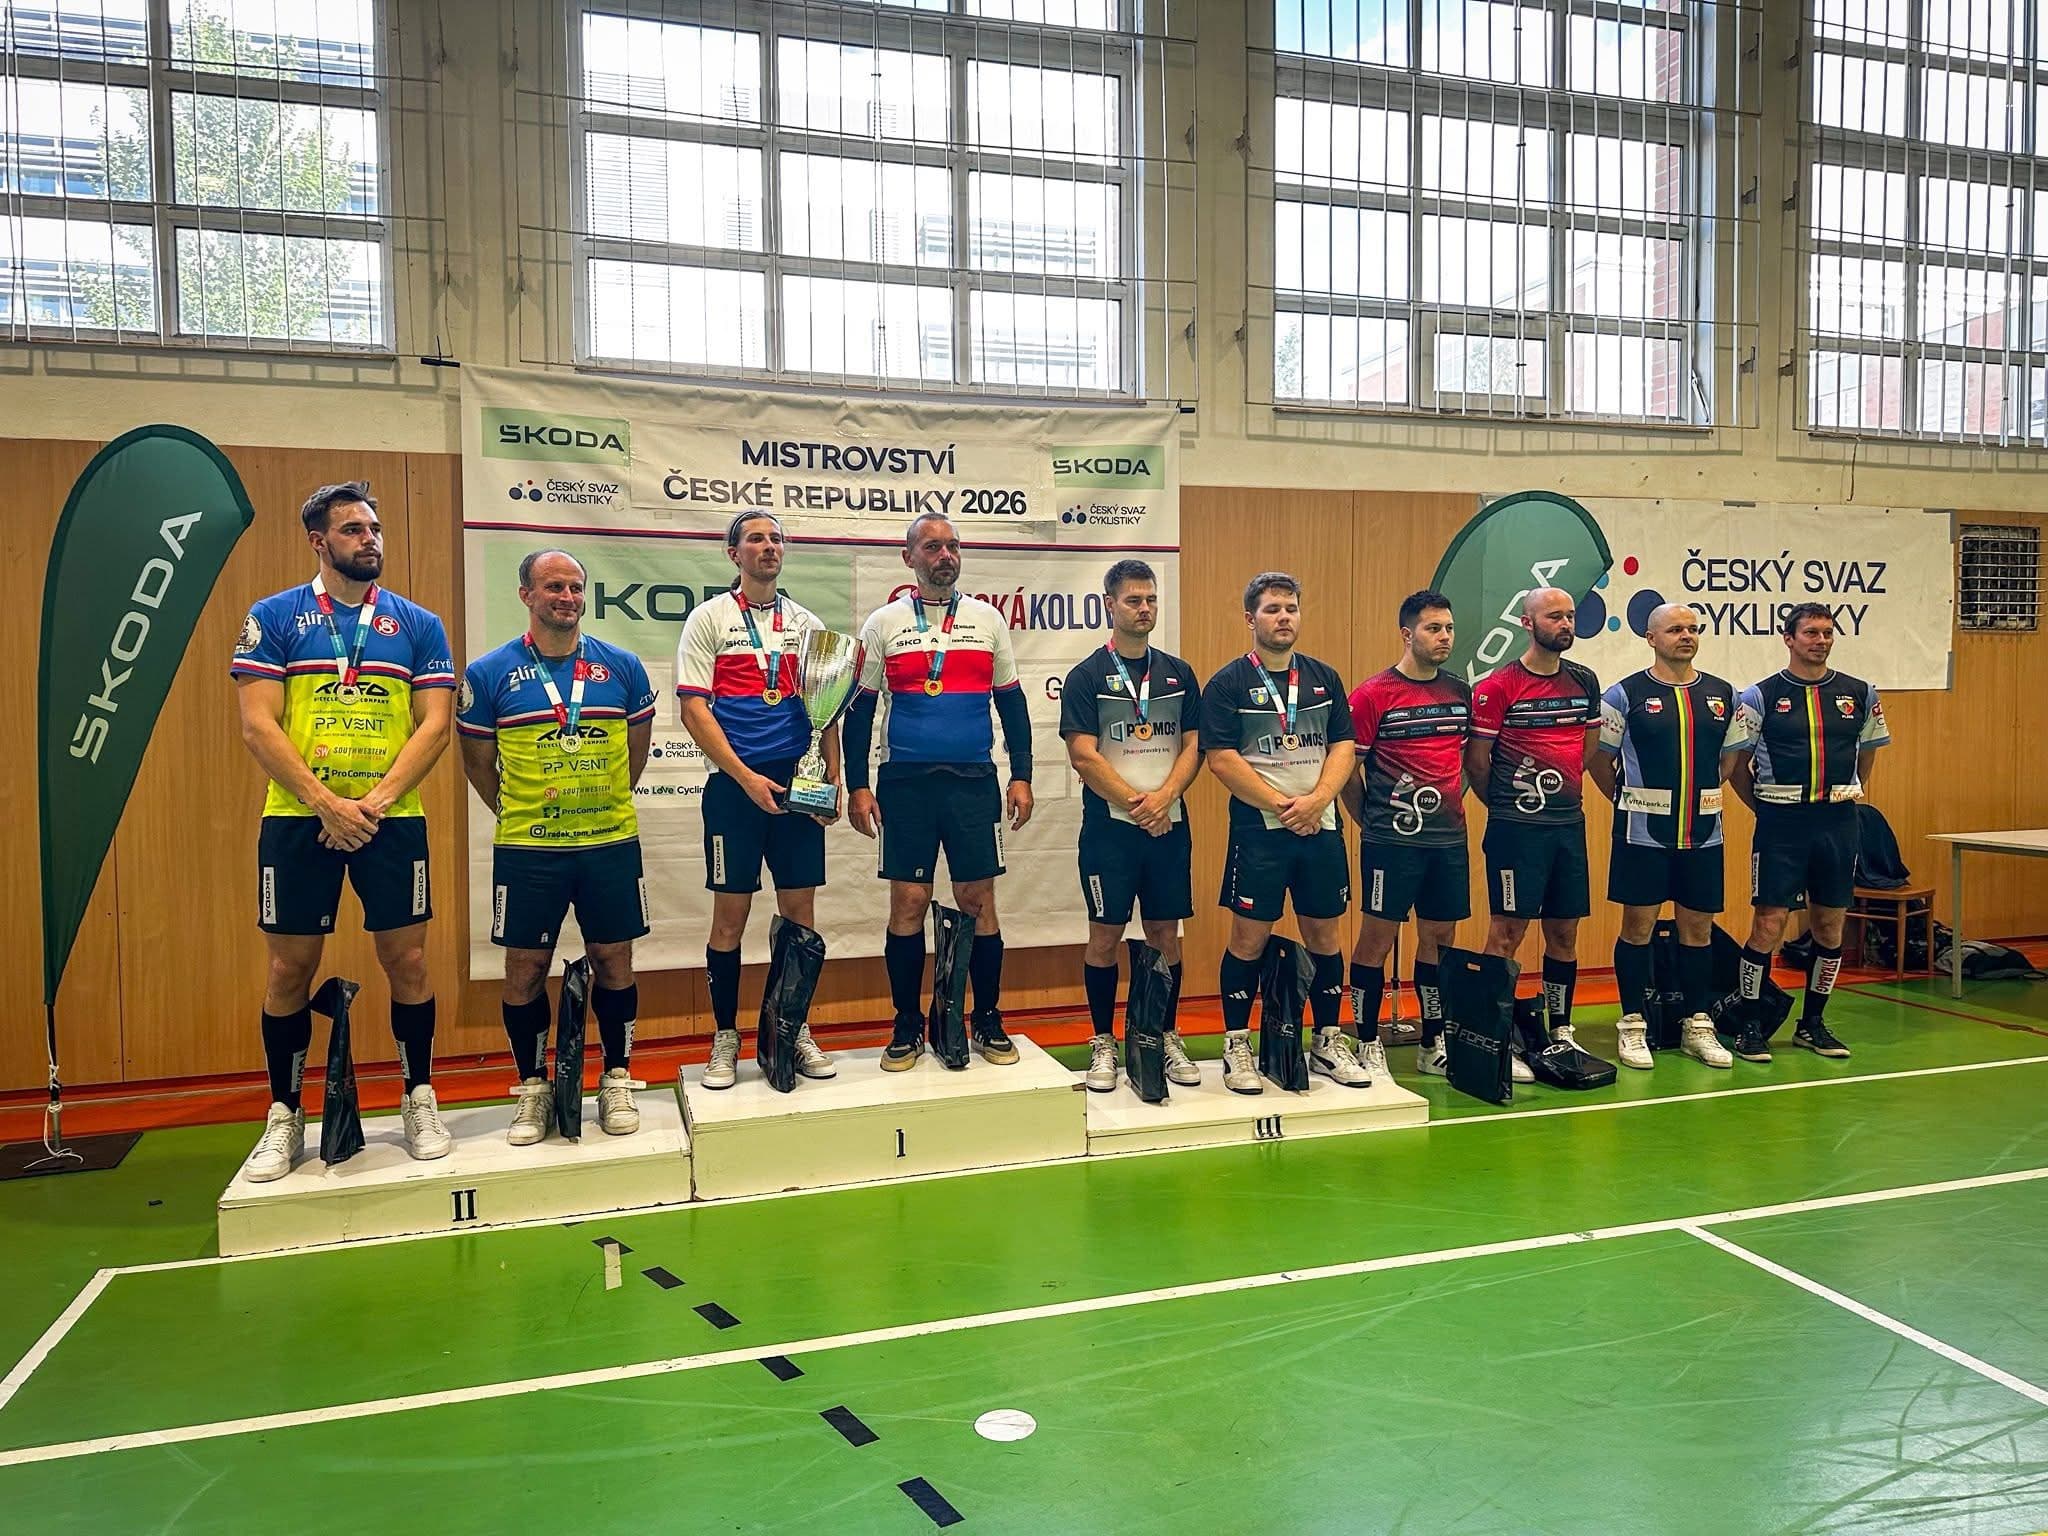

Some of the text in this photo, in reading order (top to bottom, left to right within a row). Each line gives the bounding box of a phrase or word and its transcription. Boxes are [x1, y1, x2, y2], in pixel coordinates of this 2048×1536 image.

[741, 439, 956, 475] MISTROVSTVÍ
[546, 478, 619, 495] ČESKÝ SVAZ
[662, 468, 1028, 516] ČESKÉ REPUBLIKY 2026
[546, 492, 613, 505] CYKLISTIKY
[1089, 503, 1147, 515] ČESKÝ SVAZ
[1089, 516, 1142, 526] CYKLISTIKY
[1681, 548, 1888, 594] ČESKÝ SVAZ
[360, 697, 390, 705] COMPANY
[314, 717, 337, 731] PP
[333, 746, 388, 757] SOUTHWESTERN
[665, 740, 693, 750] ČESKÝ
[543, 761, 564, 775] PP
[633, 786, 650, 796] We
[676, 785, 705, 796] Cyclin
[561, 804, 613, 816] ProComputer
[1815, 959, 1839, 994] STRABAG
[451, 1188, 478, 1223] II
